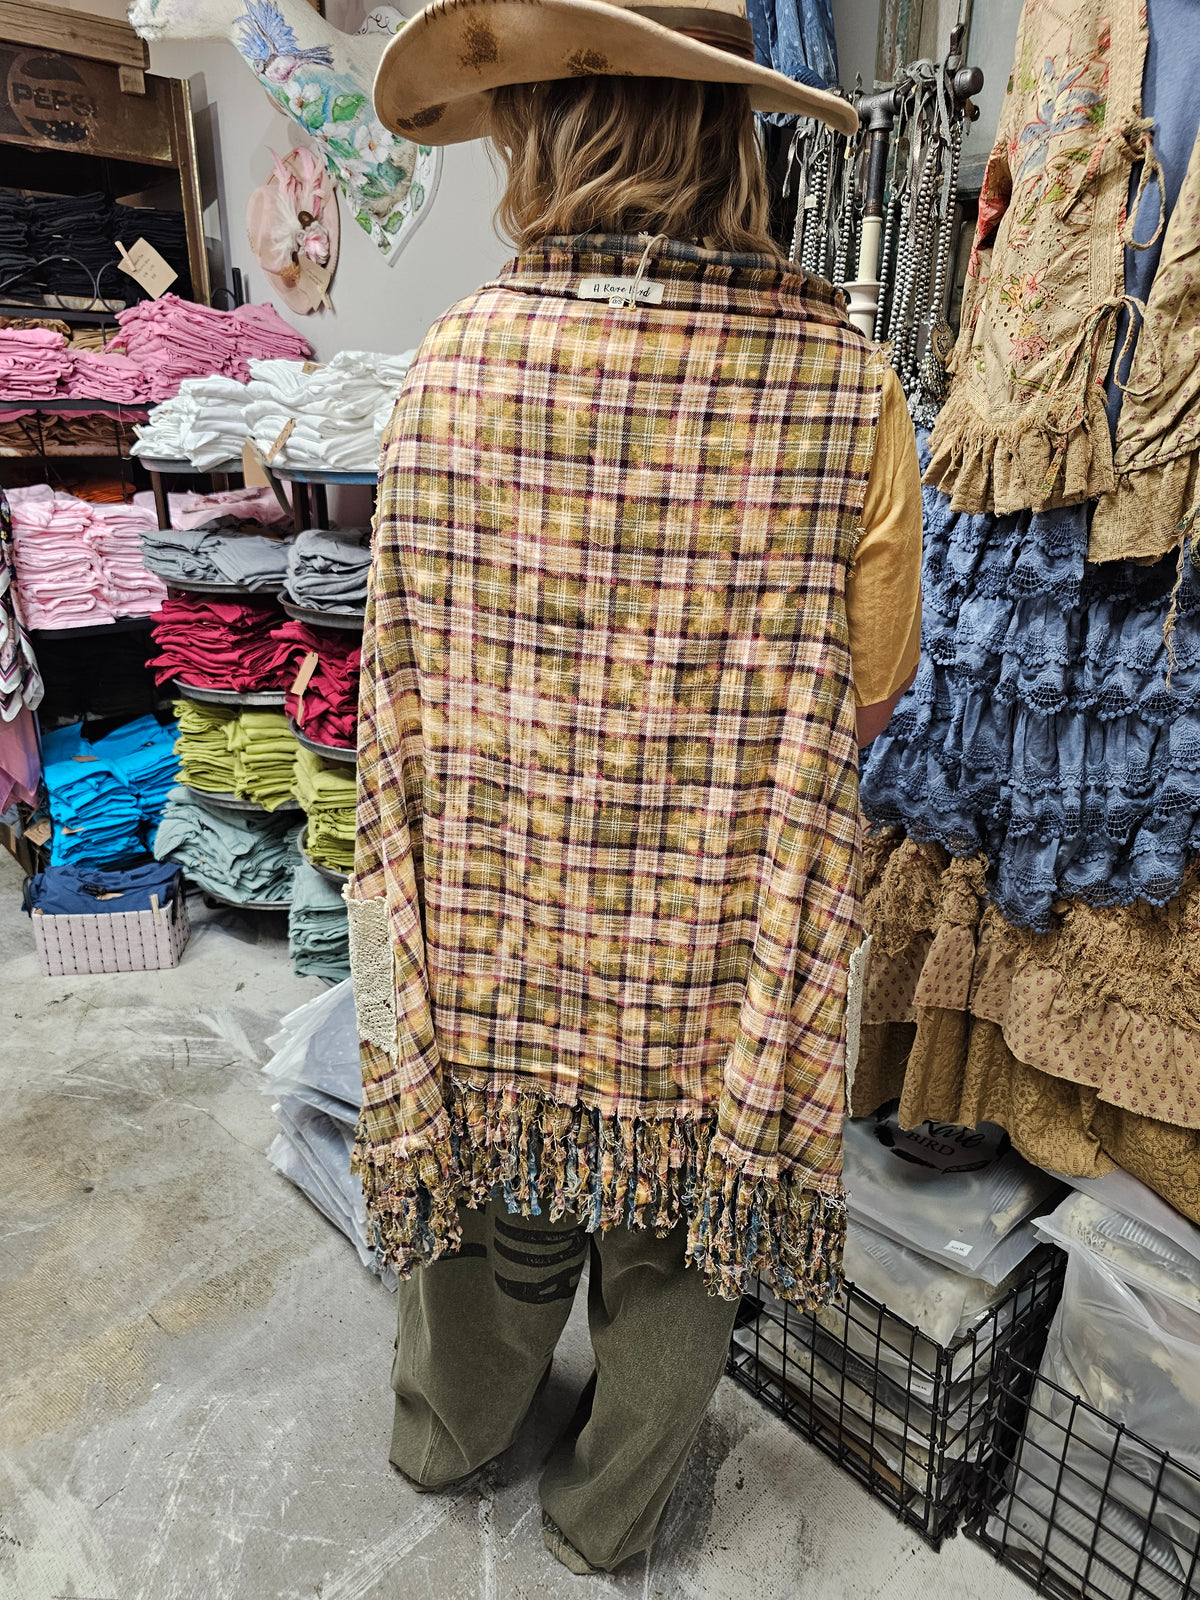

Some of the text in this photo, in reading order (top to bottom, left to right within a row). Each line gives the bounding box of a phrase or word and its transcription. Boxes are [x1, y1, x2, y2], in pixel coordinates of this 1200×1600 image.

[603, 283, 626, 293] Rare
[628, 285, 651, 297] rd
[906, 1132, 955, 1156] BIRD
